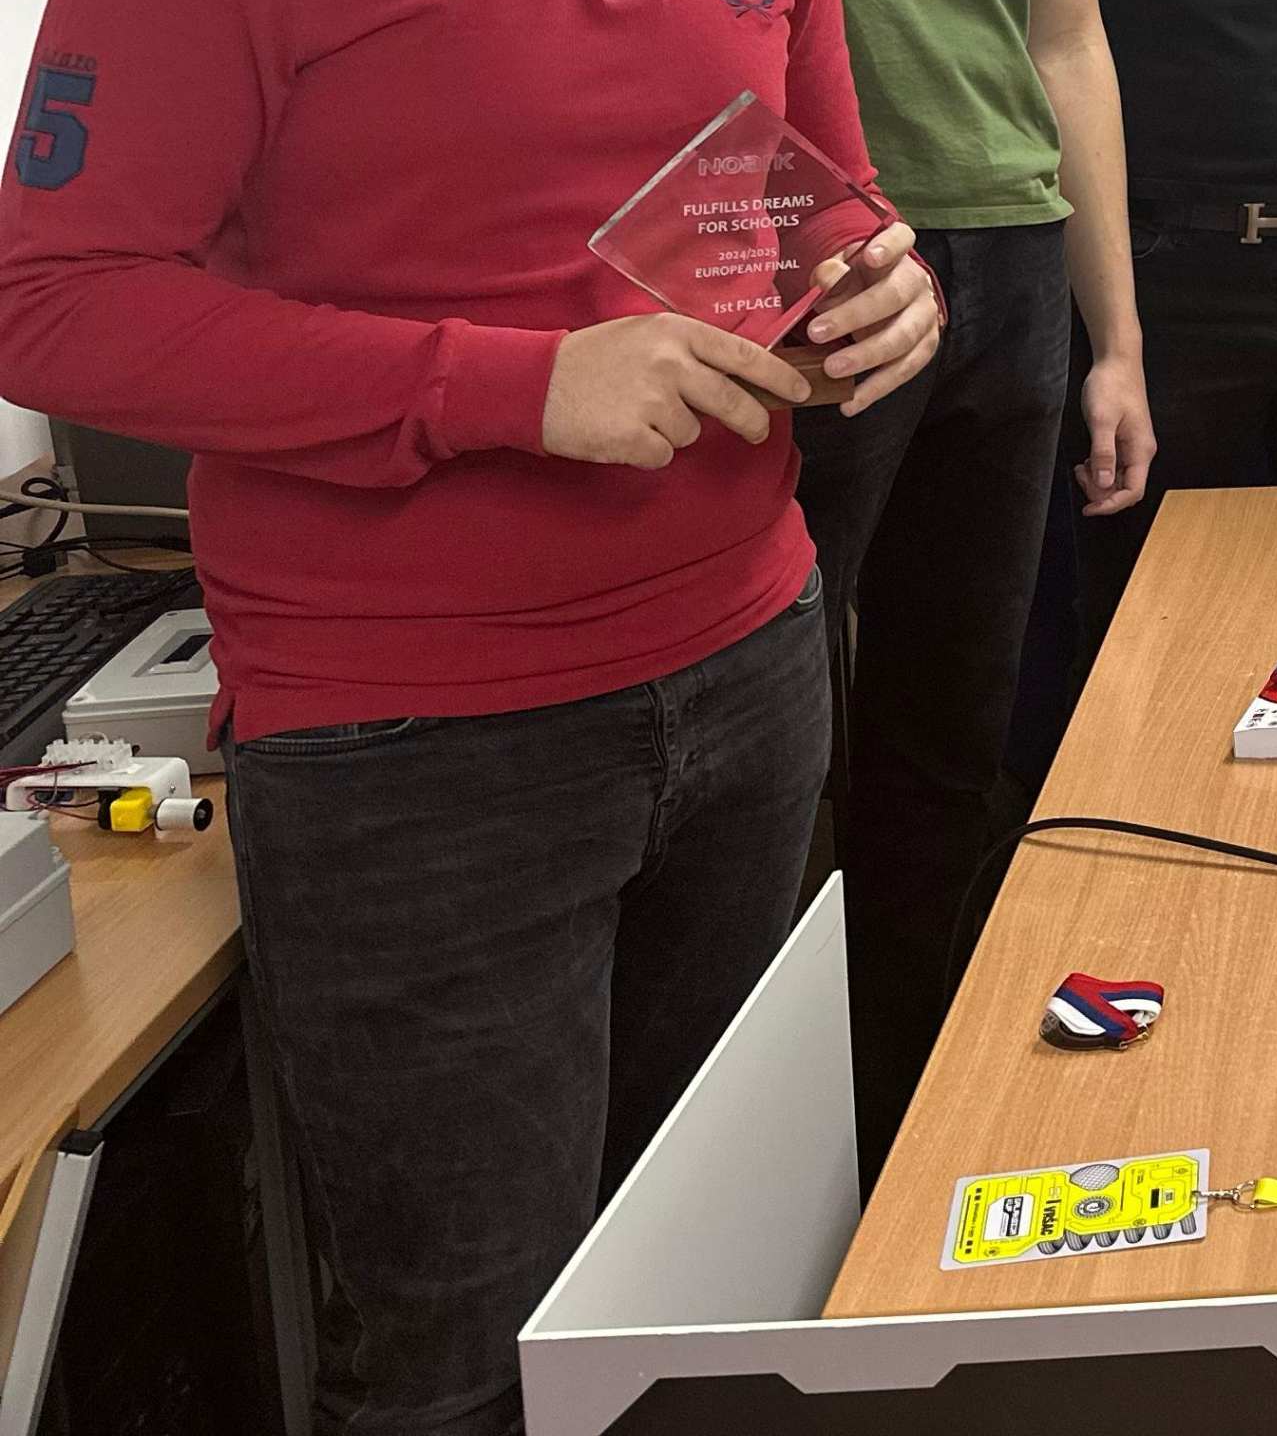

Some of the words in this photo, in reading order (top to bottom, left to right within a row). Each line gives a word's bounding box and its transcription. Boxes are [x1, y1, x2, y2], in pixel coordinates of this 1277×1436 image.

[15, 66, 96, 192] 5
[683, 199, 749, 217] FULFILLS
[752, 194, 815, 211] DREAMS
[698, 220, 729, 234] FOR
[731, 214, 800, 231] SCHOOLS
[718, 247, 777, 261] 2024/2025
[695, 264, 763, 279] EUROPEAN
[764, 259, 800, 273] FINAL
[713, 301, 734, 314] 1st
[736, 295, 782, 311] PLACE
